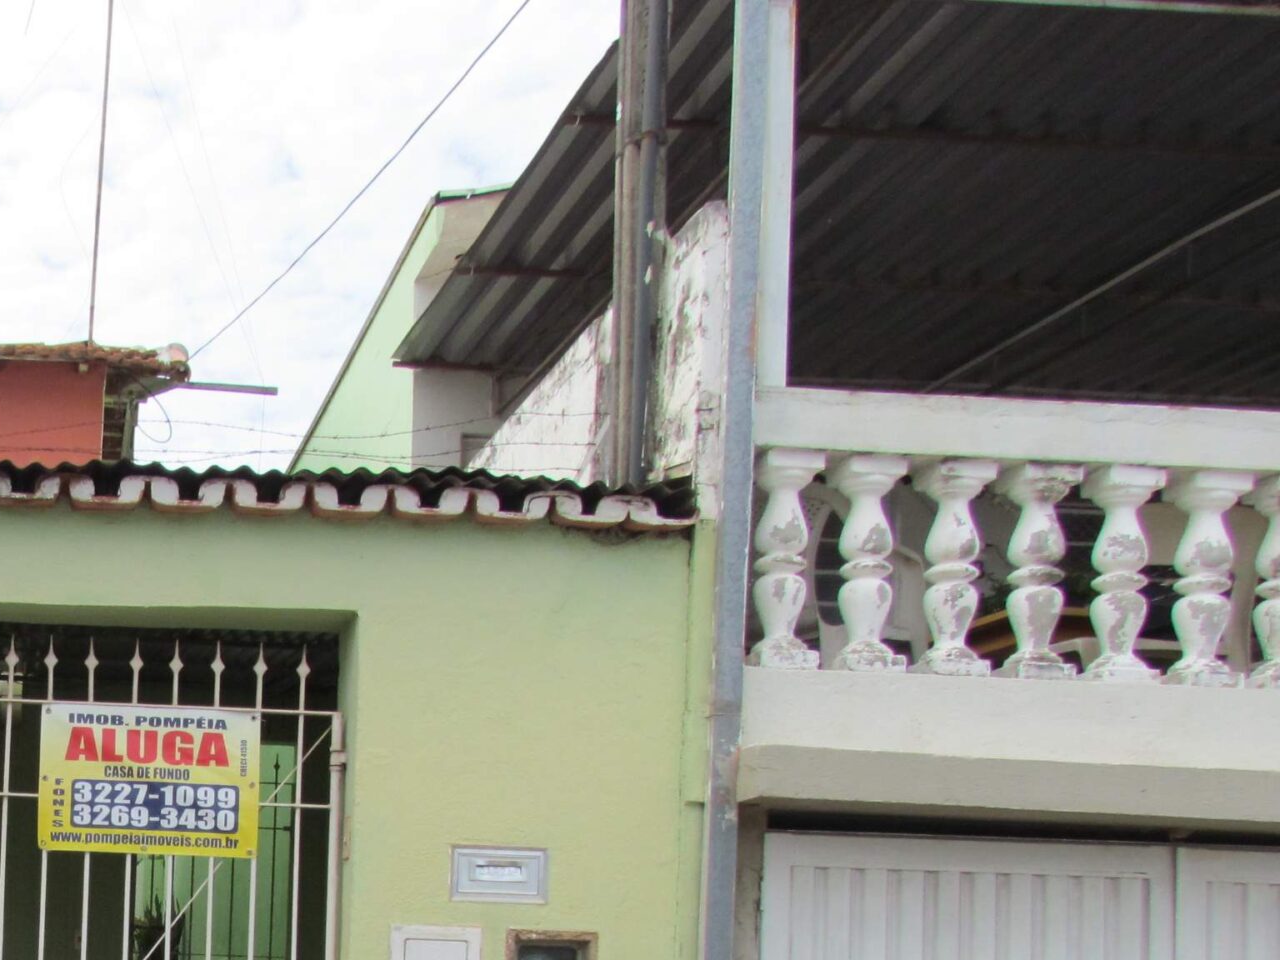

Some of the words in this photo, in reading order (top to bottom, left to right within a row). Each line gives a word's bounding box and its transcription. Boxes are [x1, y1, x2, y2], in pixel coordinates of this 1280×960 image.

[69, 713, 129, 727] IMOB.
[135, 716, 228, 730] POMPÉIA
[65, 726, 230, 767] ALUGA
[104, 766, 133, 779] CASA
[136, 767, 151, 779] DE
[153, 768, 190, 781] FUNDO
[53, 778, 64, 827] FONES
[73, 782, 237, 808] 3227-1099
[73, 804, 236, 831] 3269-3430
[50, 832, 239, 849] www.pompeiaimoveis.com.br
